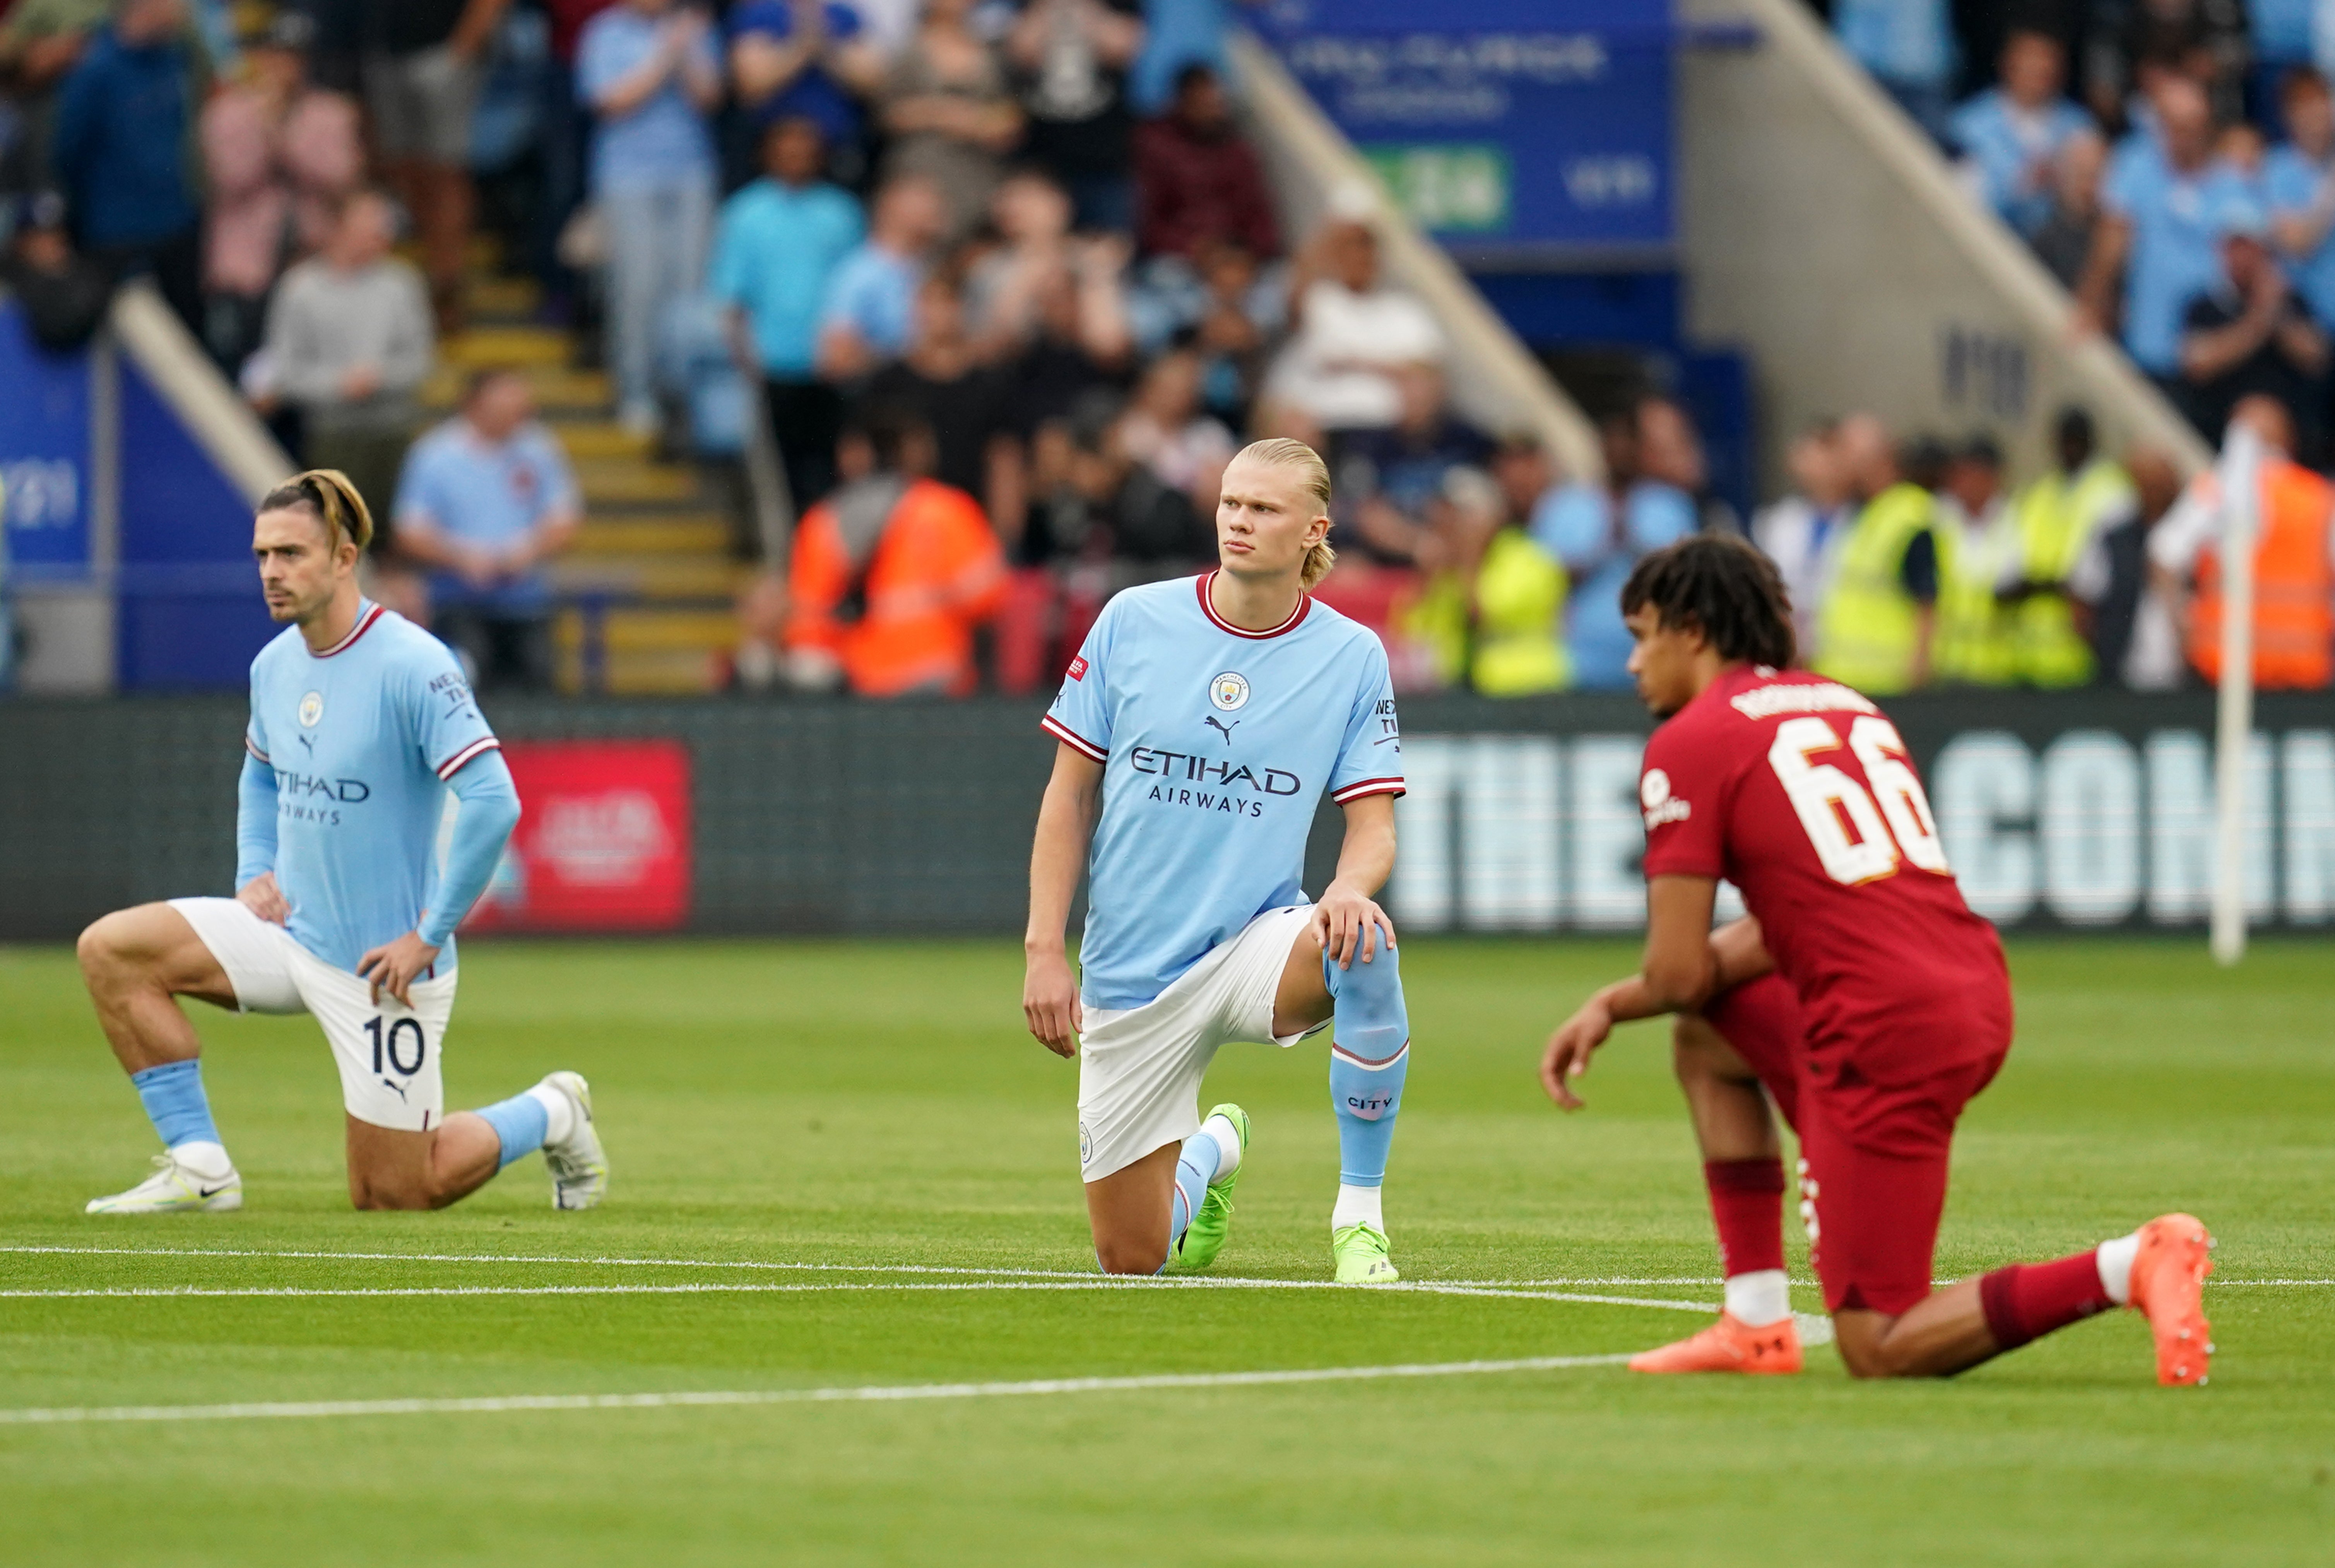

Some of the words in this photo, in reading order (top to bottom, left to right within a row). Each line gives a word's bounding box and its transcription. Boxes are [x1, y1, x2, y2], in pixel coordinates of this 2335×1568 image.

[1215, 675, 1247, 690] MANCHESTER
[1131, 746, 1301, 796] ETIHAD
[1149, 785, 1263, 817] AIRWAYS
[1768, 715, 1951, 887] 66
[1389, 736, 1645, 928] THE
[364, 1016, 424, 1076] 10
[1348, 1097, 1392, 1110] CITY
